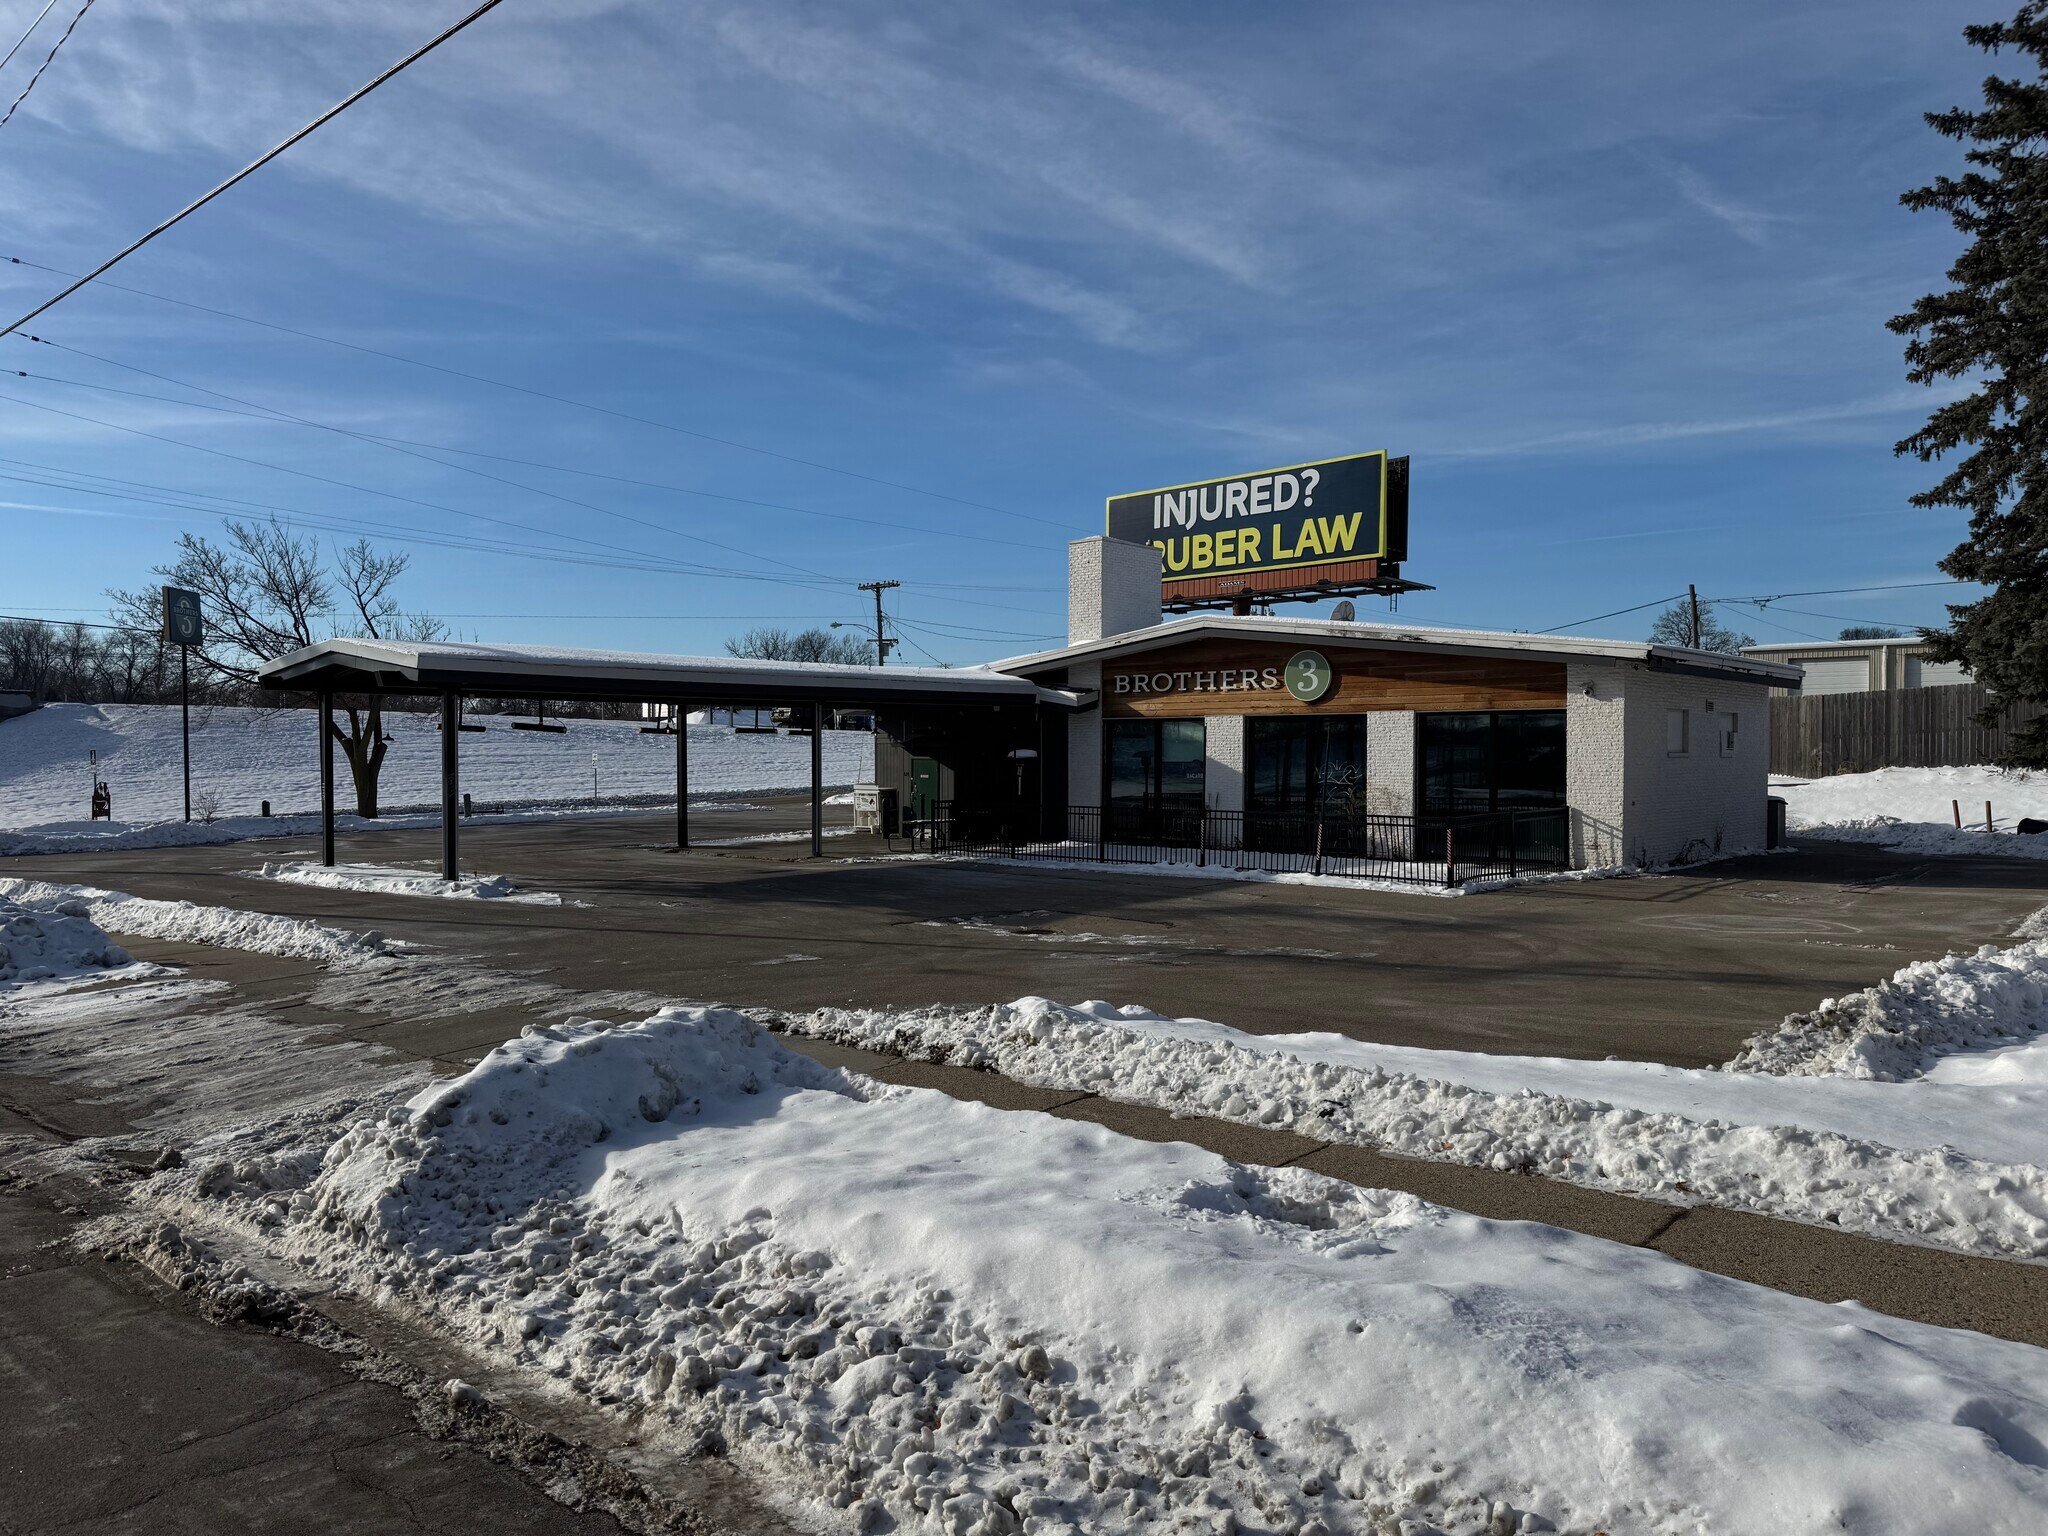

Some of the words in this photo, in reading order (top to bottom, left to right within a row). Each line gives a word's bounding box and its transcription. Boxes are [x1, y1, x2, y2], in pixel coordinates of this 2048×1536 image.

[1153, 468, 1320, 530] INJURED?
[1272, 511, 1363, 560] LAW
[173, 606, 198, 616] BROTHERS
[1114, 667, 1279, 694] BROTHERS
[1297, 659, 1318, 692] 3
